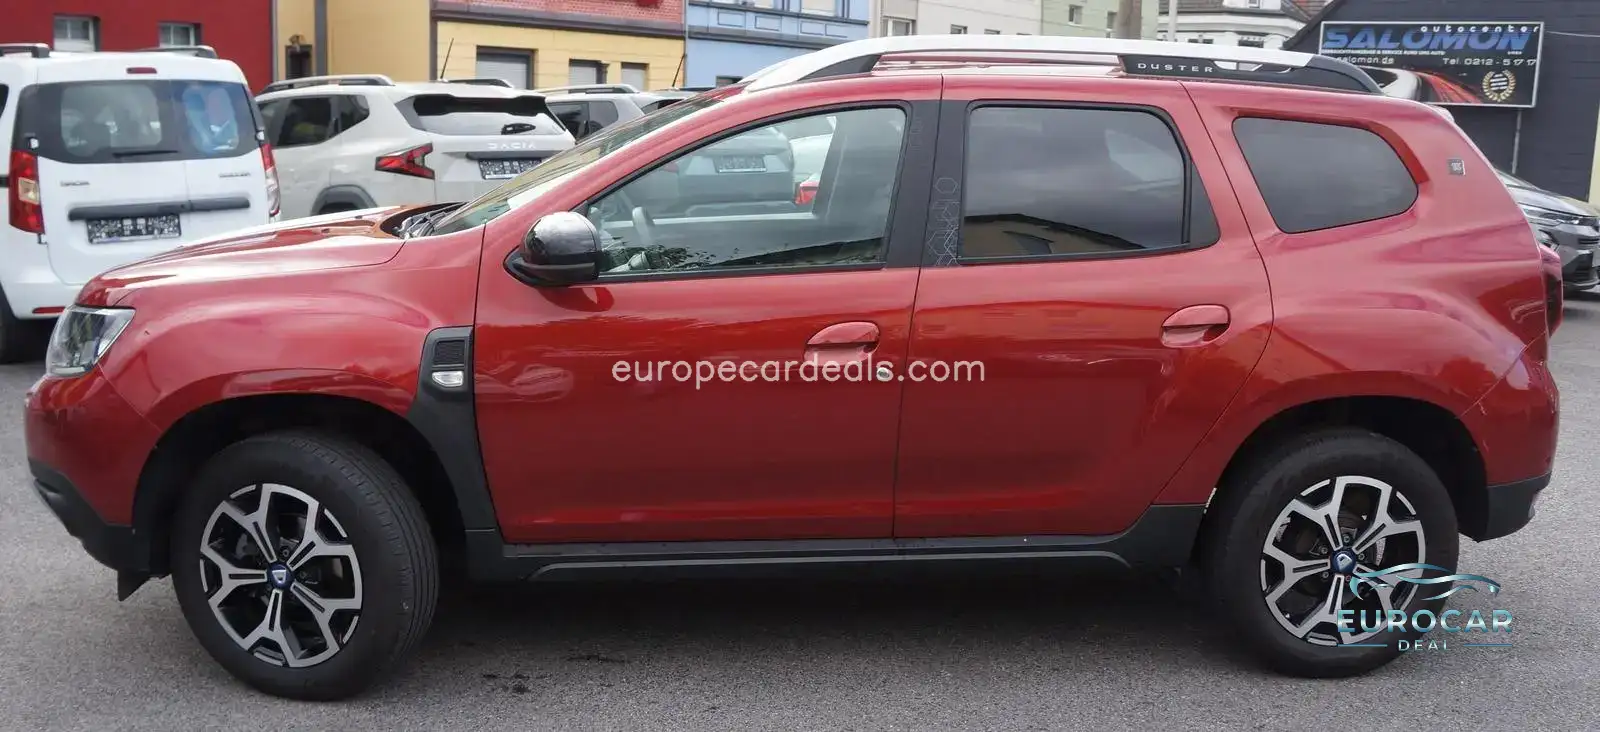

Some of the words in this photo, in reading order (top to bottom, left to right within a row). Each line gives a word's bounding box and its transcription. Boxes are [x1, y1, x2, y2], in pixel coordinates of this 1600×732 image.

[1322, 27, 1532, 50] SALOMON
[1464, 58, 1493, 66] 0212
[1137, 63, 1213, 72] DUSTER
